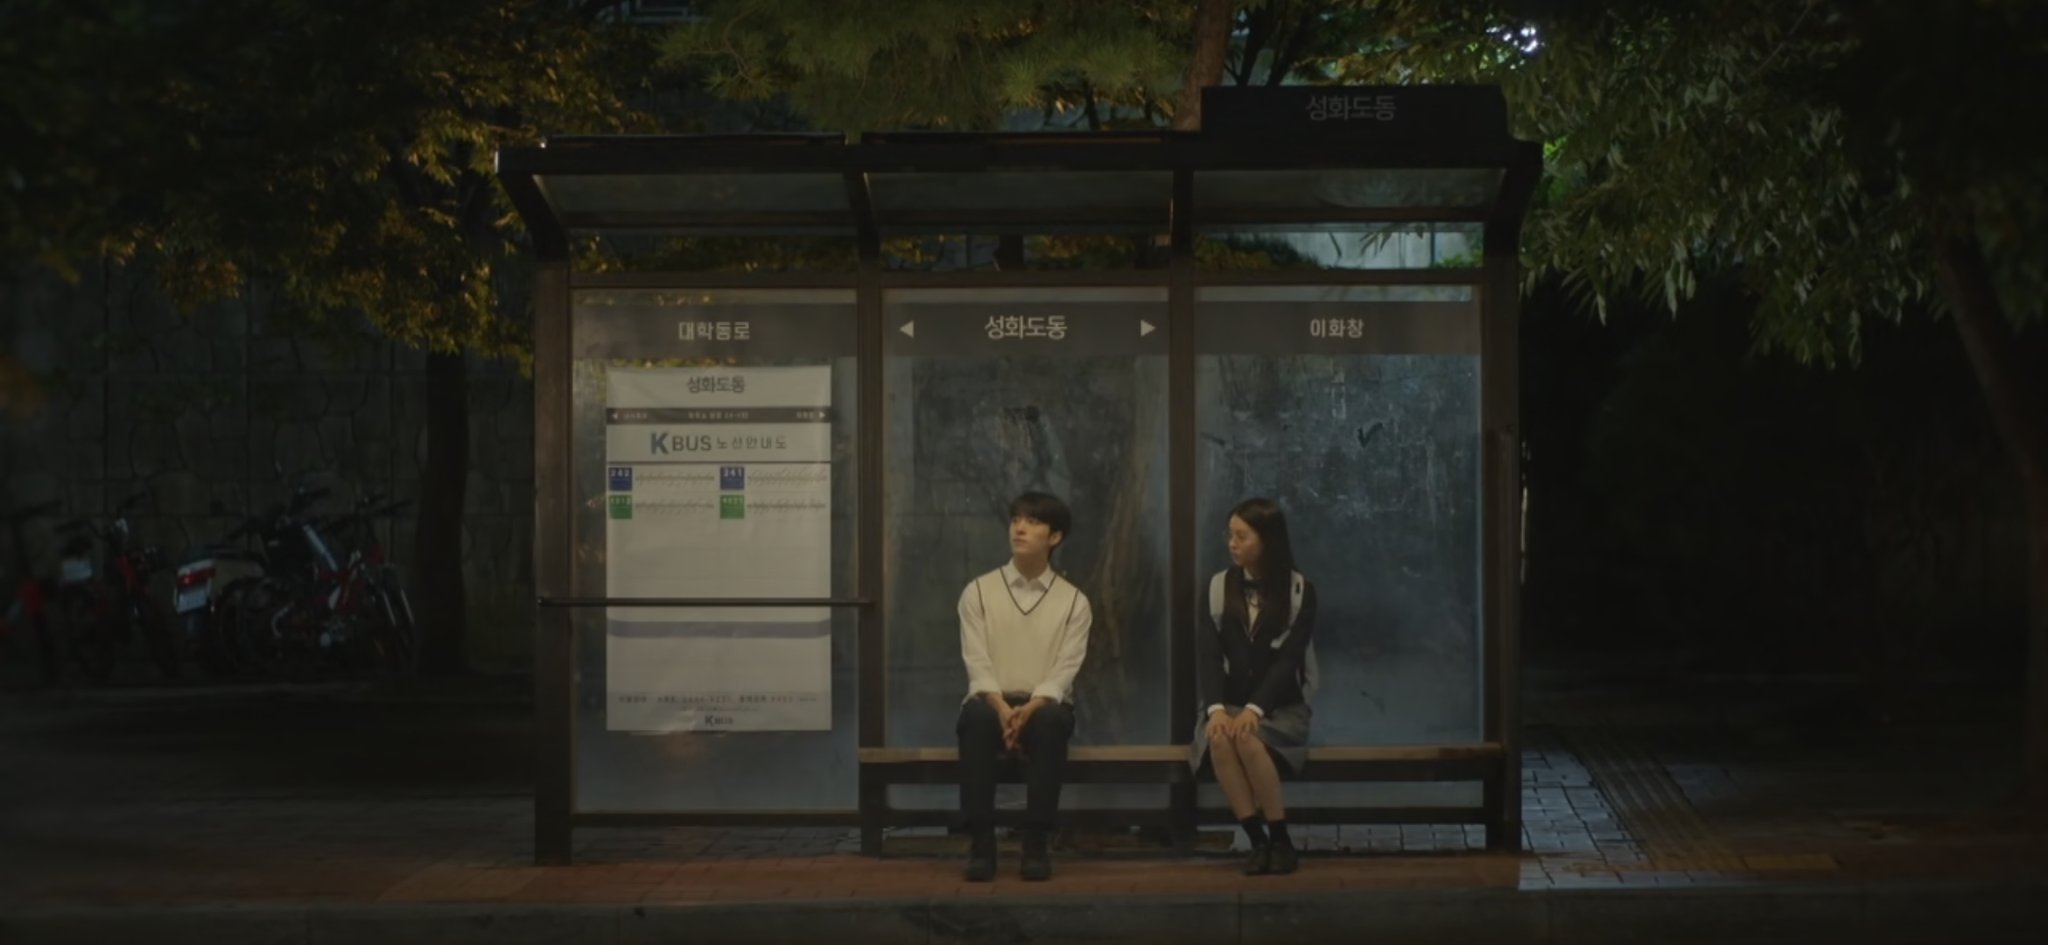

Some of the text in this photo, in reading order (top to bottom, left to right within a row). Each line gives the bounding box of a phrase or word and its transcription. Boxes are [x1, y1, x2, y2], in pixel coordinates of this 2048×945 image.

[1305, 95, 1397, 121] 성화도동
[678, 321, 750, 341] 대학동로
[984, 315, 1068, 341] 성화도동
[1310, 317, 1364, 339] 이화창
[687, 375, 745, 394] 성화도동
